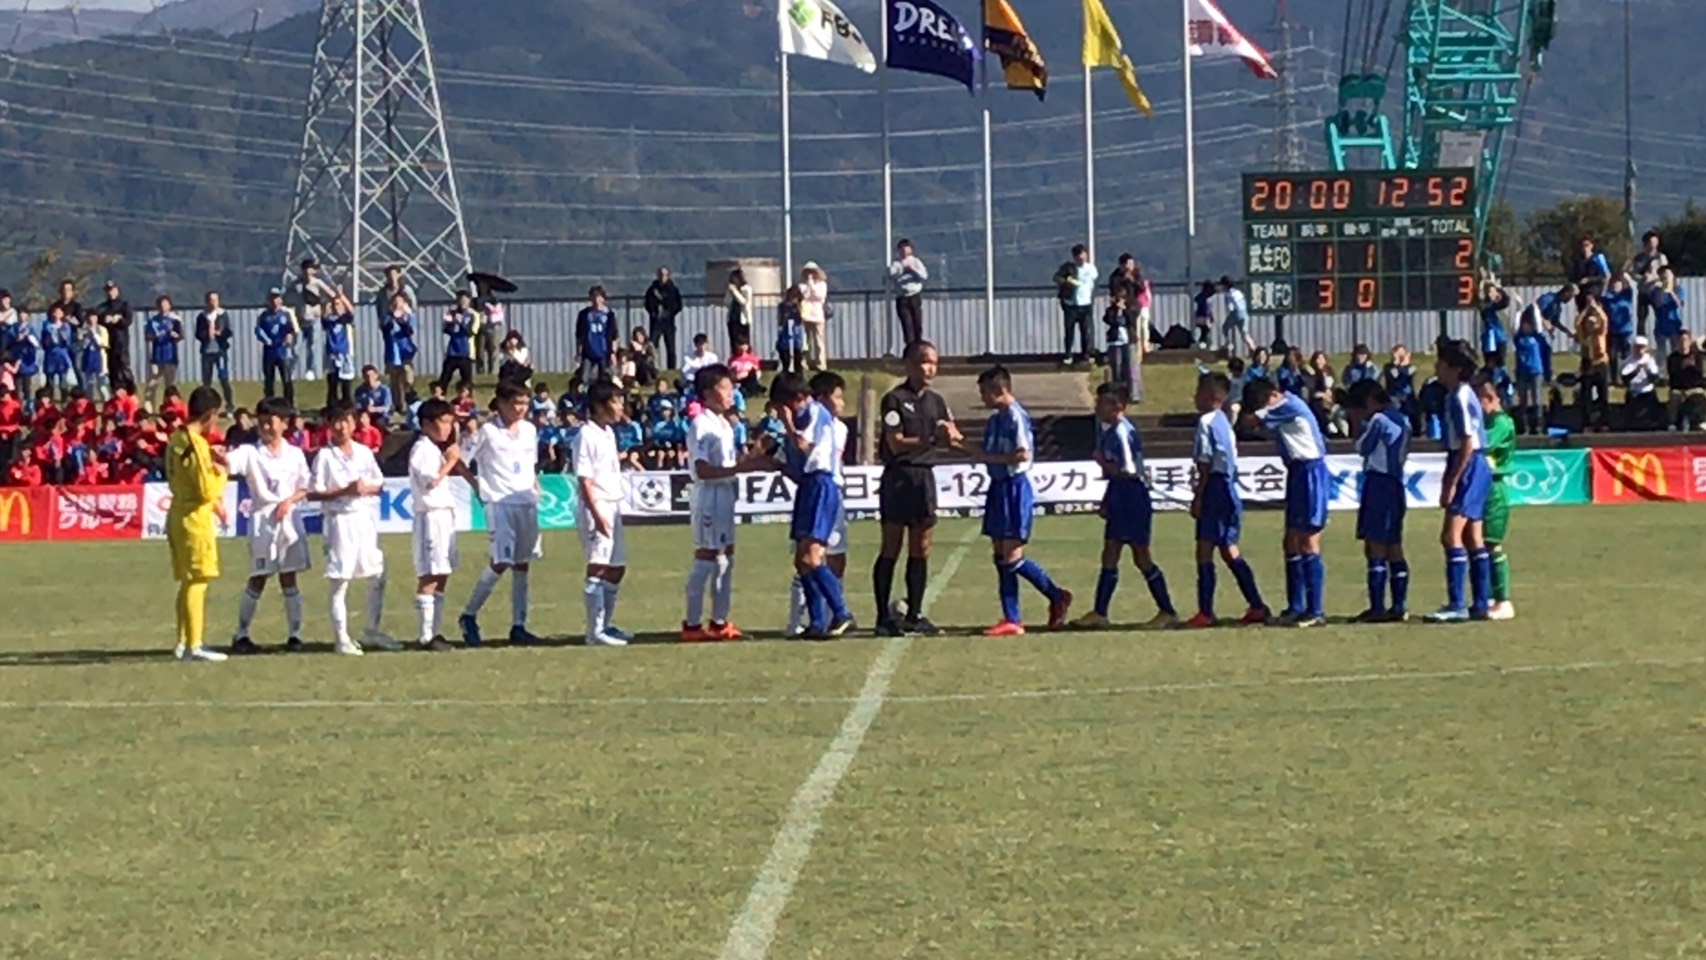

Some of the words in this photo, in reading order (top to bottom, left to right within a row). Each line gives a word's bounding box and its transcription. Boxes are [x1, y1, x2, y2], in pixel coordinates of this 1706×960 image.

[893, 1, 961, 42] DRE
[1251, 224, 1288, 239] TEAM
[1431, 219, 1470, 234] TOTAL
[1325, 244, 1334, 271] 1
[1366, 243, 1375, 270] 1
[1455, 239, 1474, 268] 2
[1318, 279, 1335, 310] 3
[1357, 278, 1376, 309] 0
[1458, 276, 1475, 306] 3
